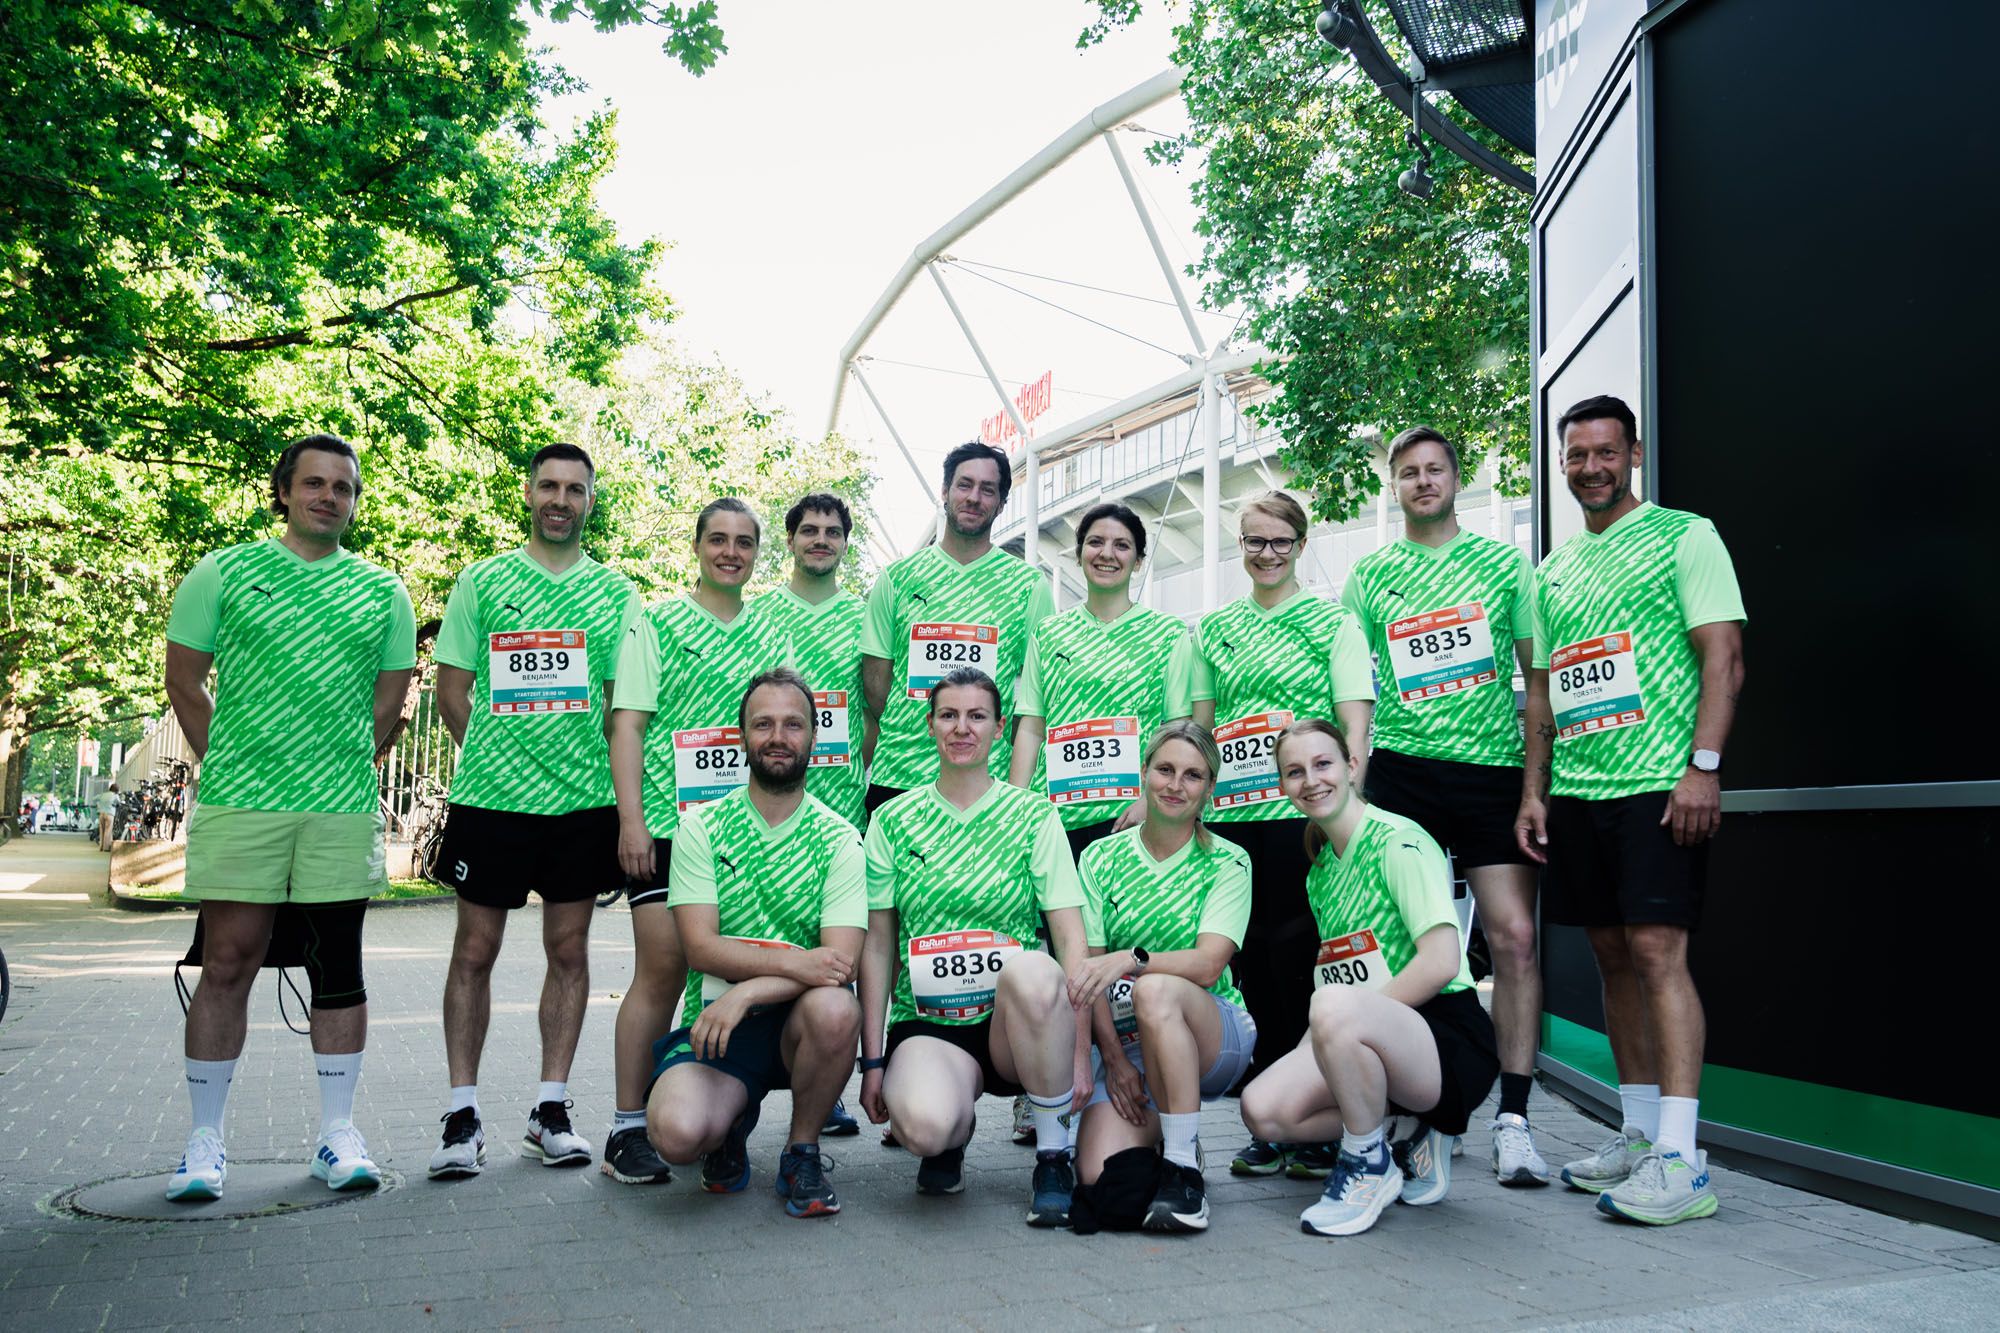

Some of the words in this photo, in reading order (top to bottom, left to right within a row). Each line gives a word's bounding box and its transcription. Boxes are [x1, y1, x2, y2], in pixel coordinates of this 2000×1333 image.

[925, 642, 981, 663] 8828
[1409, 626, 1471, 658] 8835
[509, 651, 569, 673] 8839
[1434, 652, 1454, 662] ARNE
[522, 673, 558, 681] BENJAMIN
[1560, 659, 1615, 693] 8840
[1572, 686, 1603, 698] TORSTEN
[1063, 738, 1121, 762] 8833
[1222, 735, 1276, 764] 8829
[1233, 759, 1268, 771] CHRISTINE
[932, 951, 1003, 978] 8836
[1321, 959, 1369, 985] 8830
[962, 977, 976, 985] PIA
